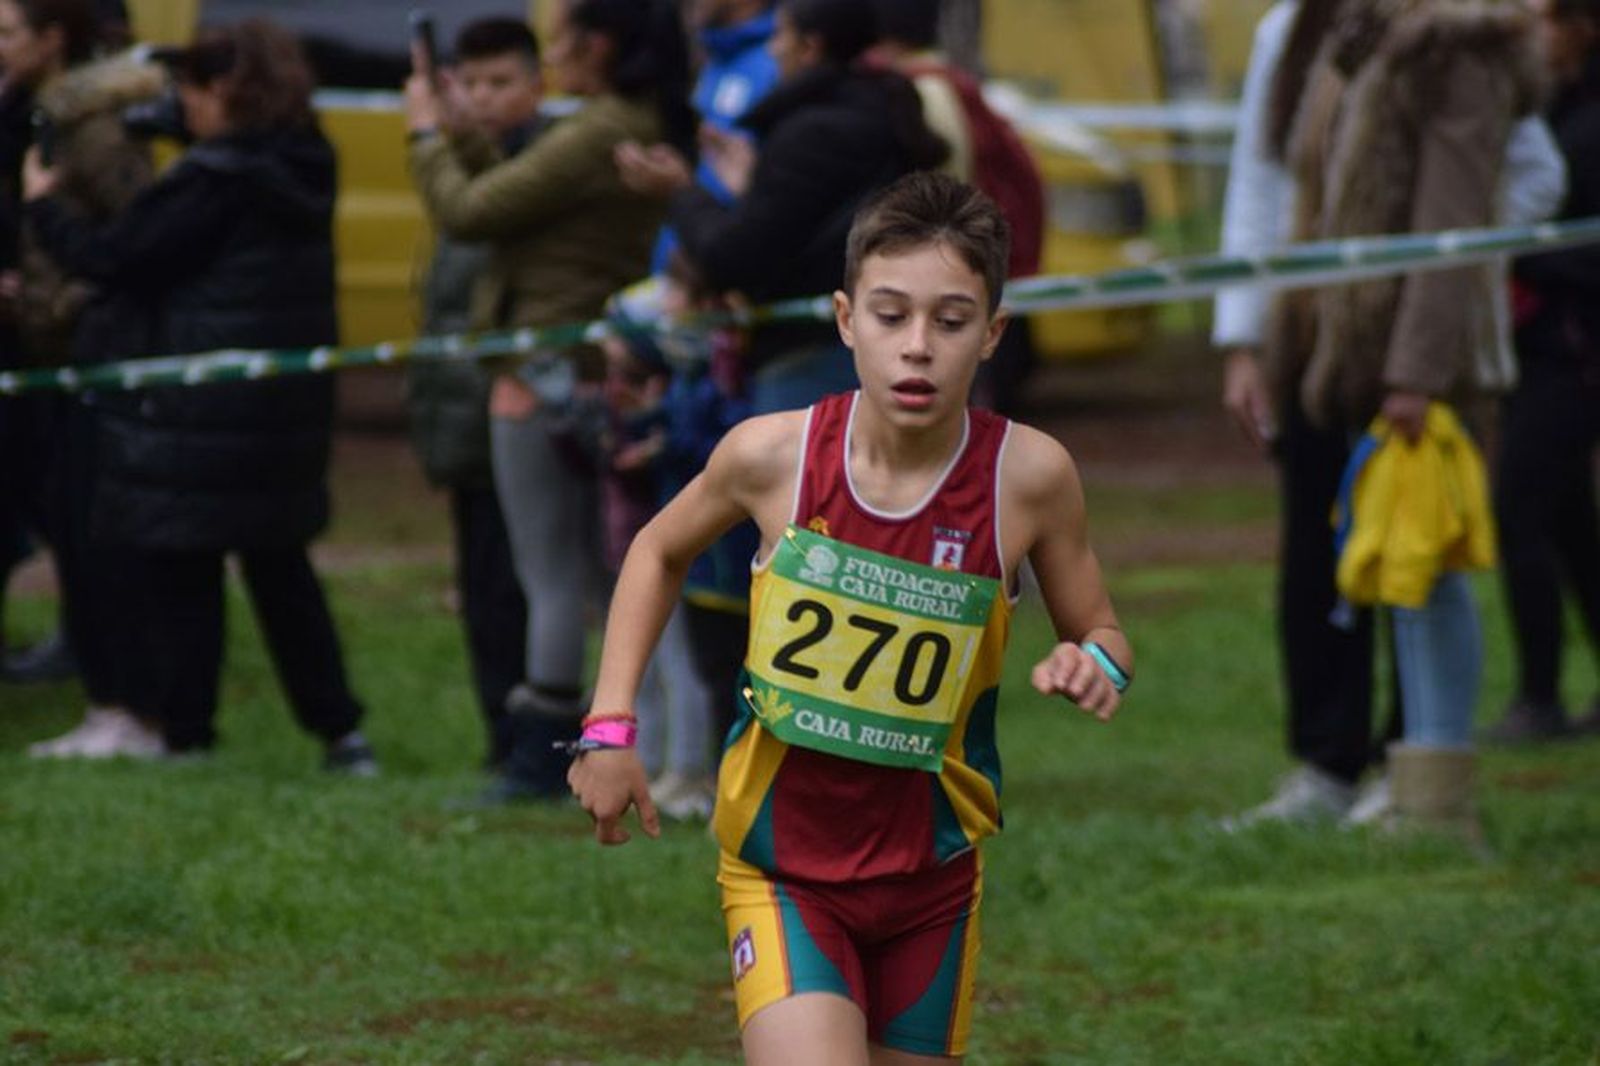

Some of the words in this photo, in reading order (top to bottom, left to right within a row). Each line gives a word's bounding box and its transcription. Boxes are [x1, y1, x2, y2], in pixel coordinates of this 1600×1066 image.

[840, 575, 888, 604] CAJA
[893, 591, 961, 619] RURAL
[771, 599, 951, 706] 270
[795, 710, 852, 742] CAJA
[858, 725, 935, 755] RURAL
